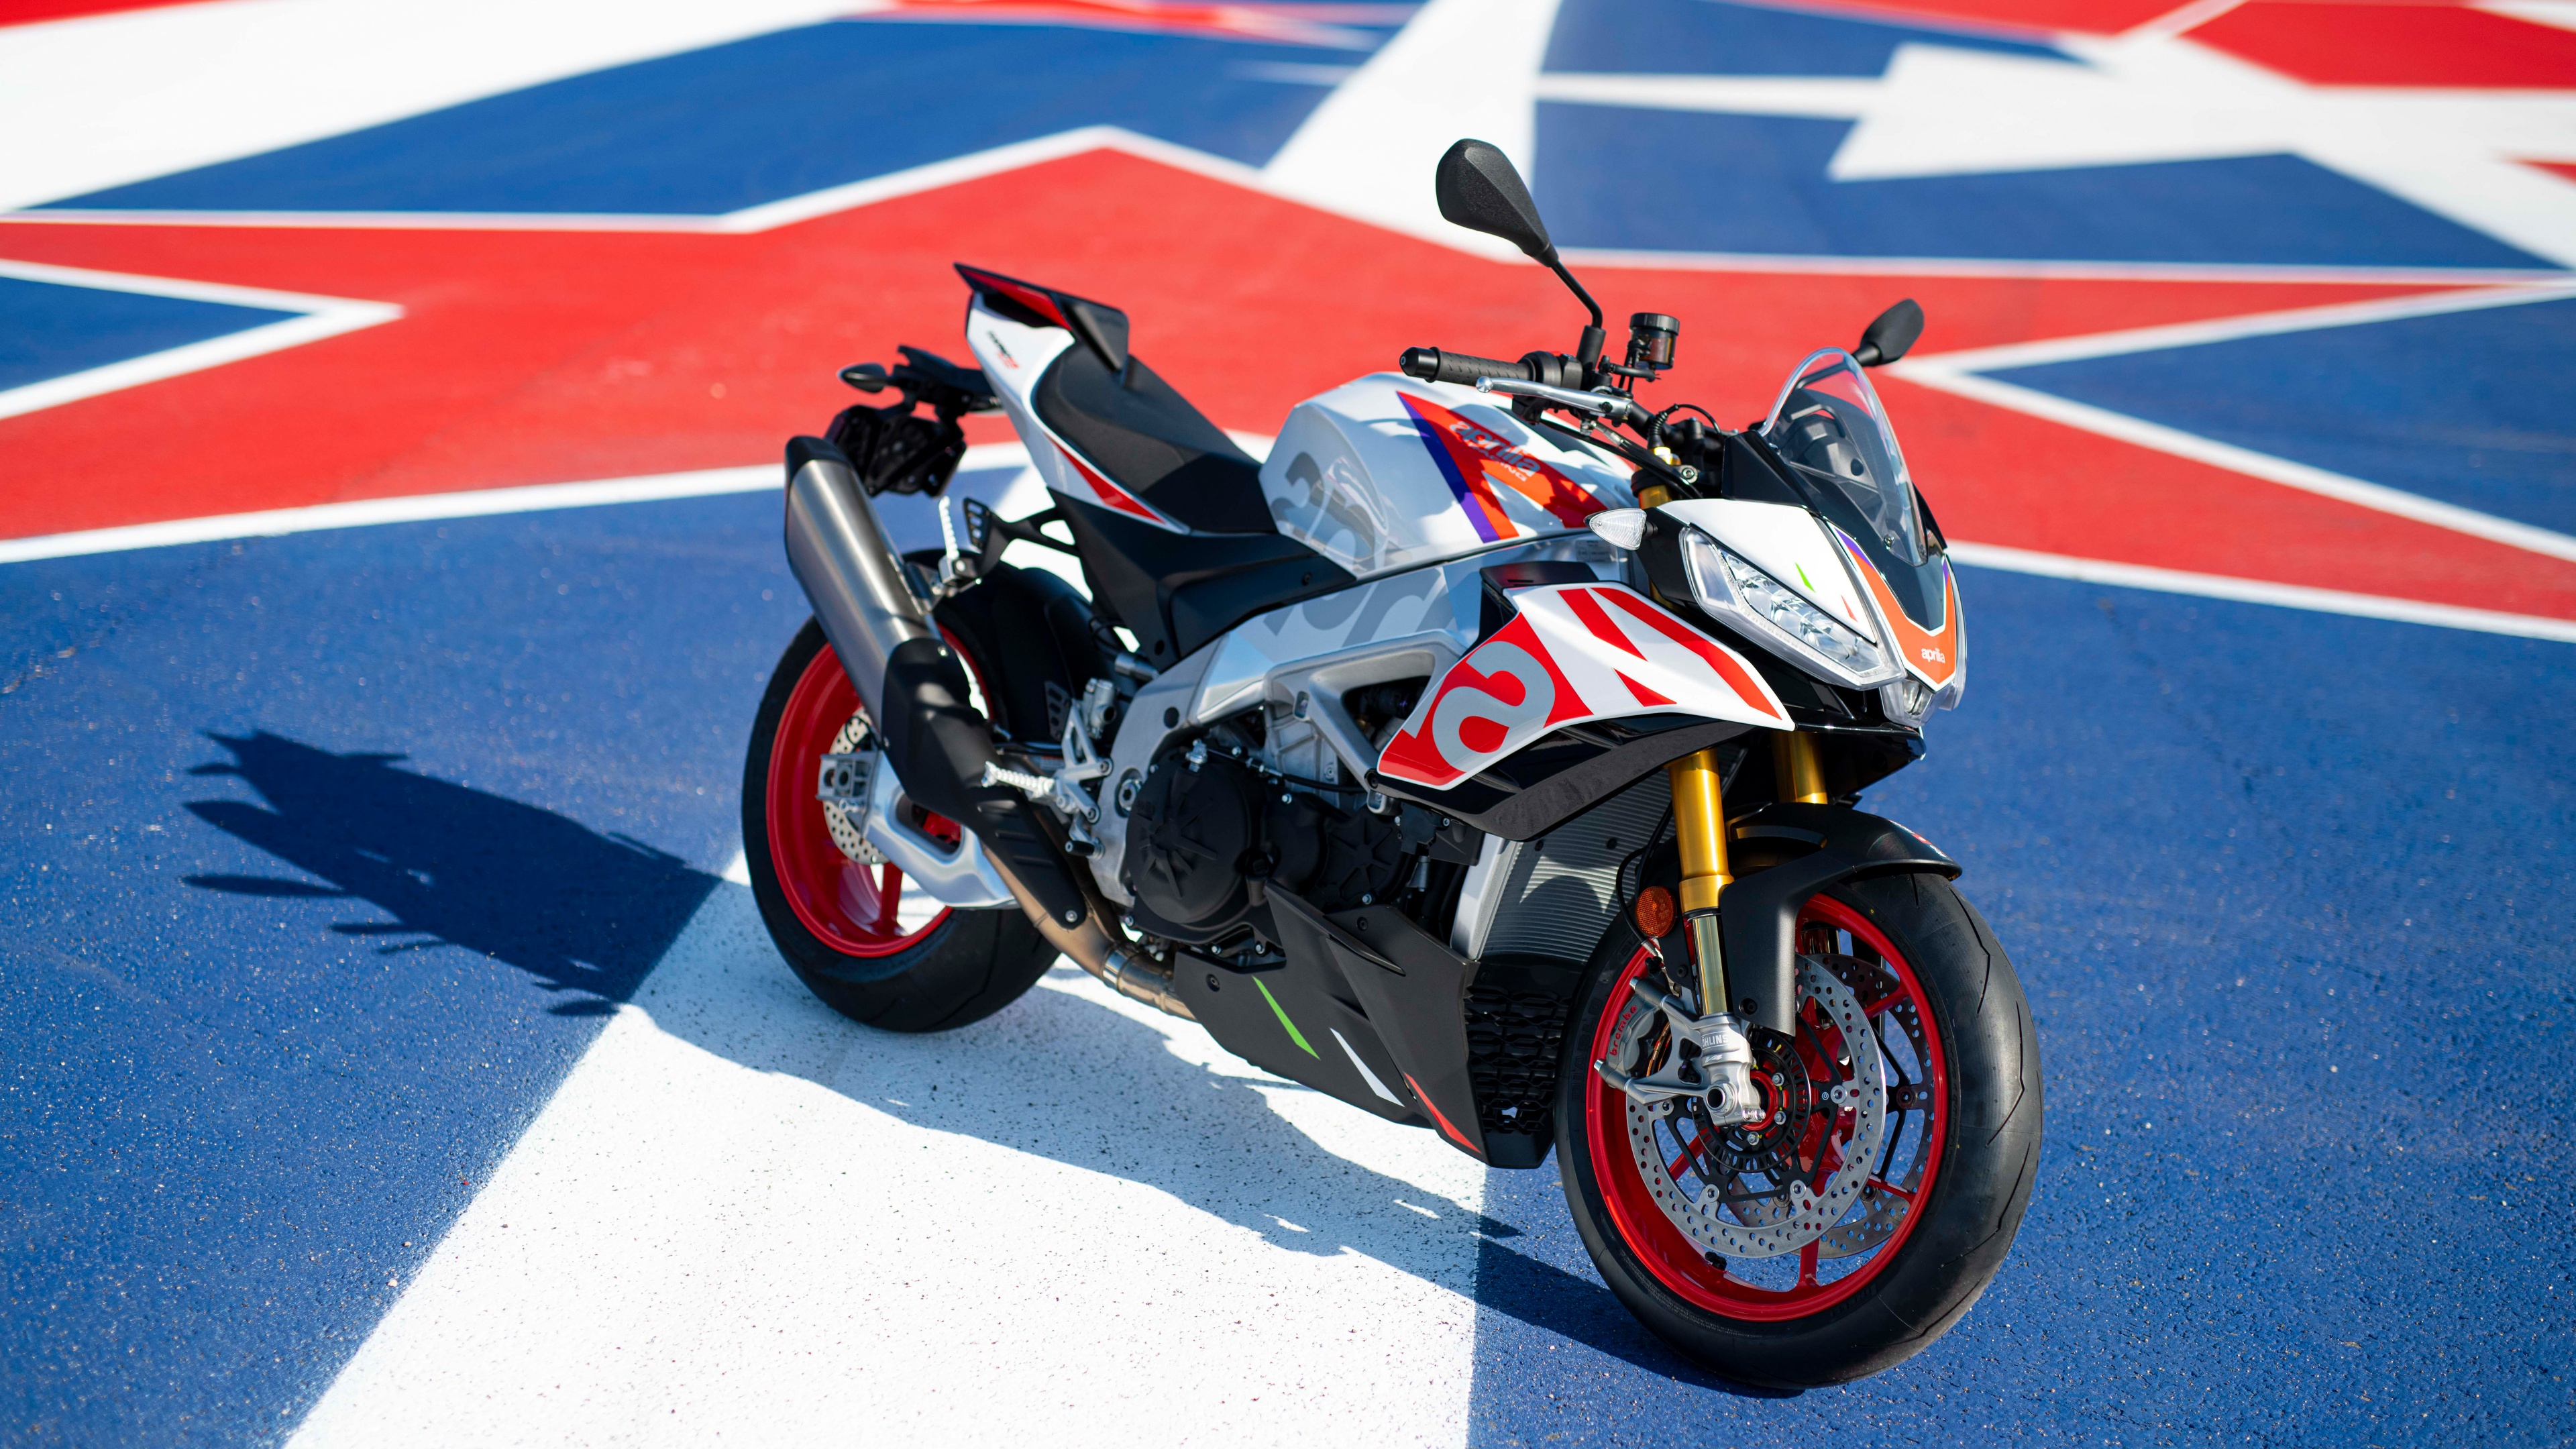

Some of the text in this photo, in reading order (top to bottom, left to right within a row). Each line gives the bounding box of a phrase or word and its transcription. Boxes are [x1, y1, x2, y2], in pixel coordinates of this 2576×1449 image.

[1450, 421, 1541, 477] aprilia
[1921, 647, 1945, 663] aprilia
[1610, 1006, 1637, 1056] brembo
